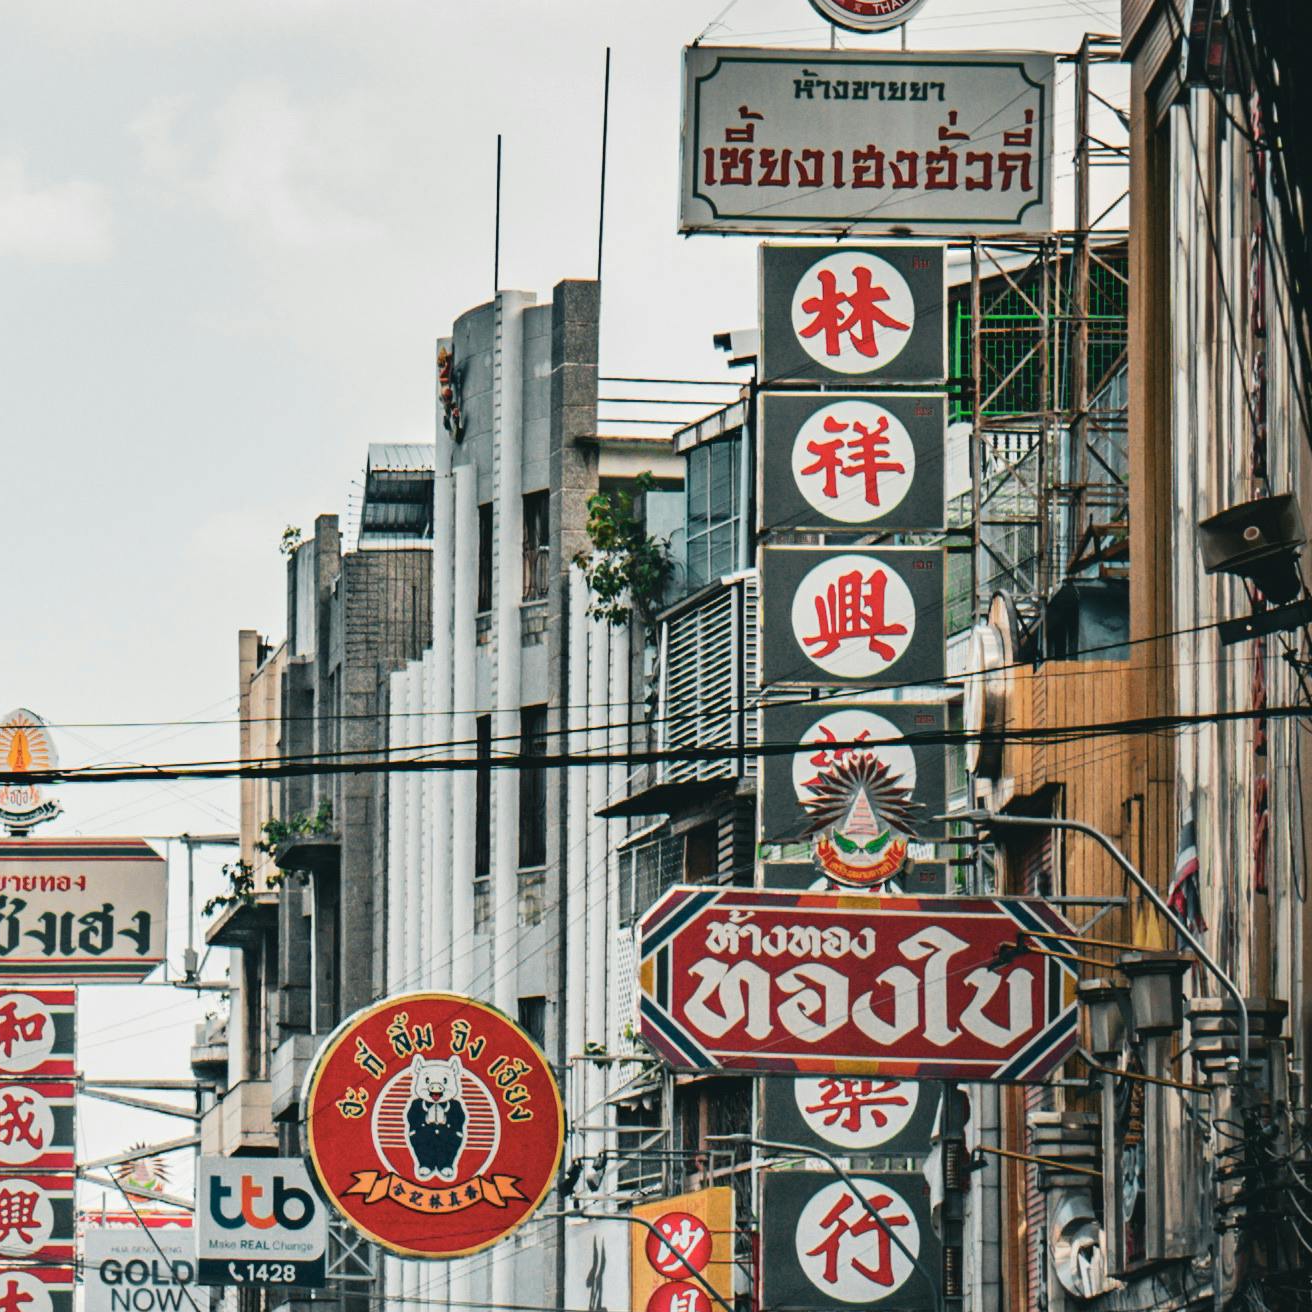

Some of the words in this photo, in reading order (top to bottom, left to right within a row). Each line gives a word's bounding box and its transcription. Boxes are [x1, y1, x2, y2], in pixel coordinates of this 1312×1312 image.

[792, 68, 947, 102] ห้างขายยา
[704, 909, 878, 960] ห้างทอง
[682, 924, 1035, 1050] ทองใบ
[209, 1174, 316, 1231] ttb
[208, 1239, 237, 1250] Make
[240, 1239, 271, 1250] REAL
[272, 1239, 314, 1252] Change
[99, 1259, 195, 1286] GOLD
[246, 1263, 296, 1283] 1428
[111, 1287, 184, 1312] NOW
